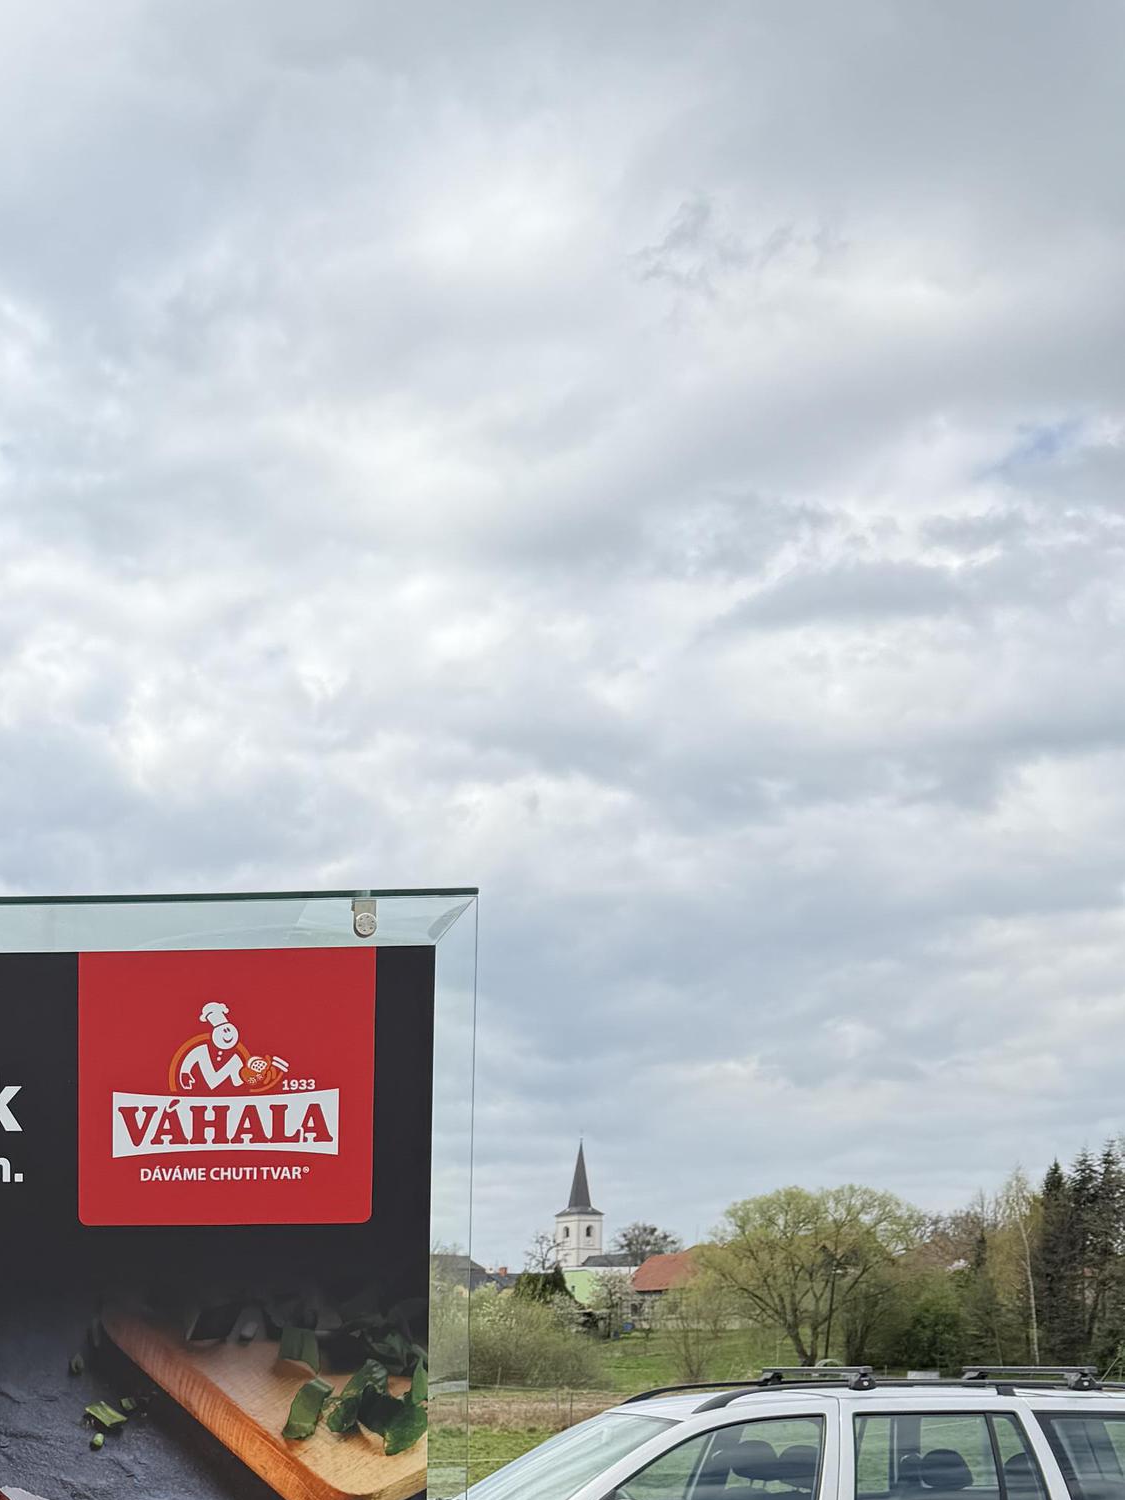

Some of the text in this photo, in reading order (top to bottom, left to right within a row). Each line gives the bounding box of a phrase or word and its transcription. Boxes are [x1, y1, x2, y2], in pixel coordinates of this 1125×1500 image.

[282, 1079, 316, 1091] 1933
[117, 1099, 334, 1147] VÁHALA
[140, 1165, 207, 1182] DÁVÁME
[209, 1166, 258, 1181] CHUTI
